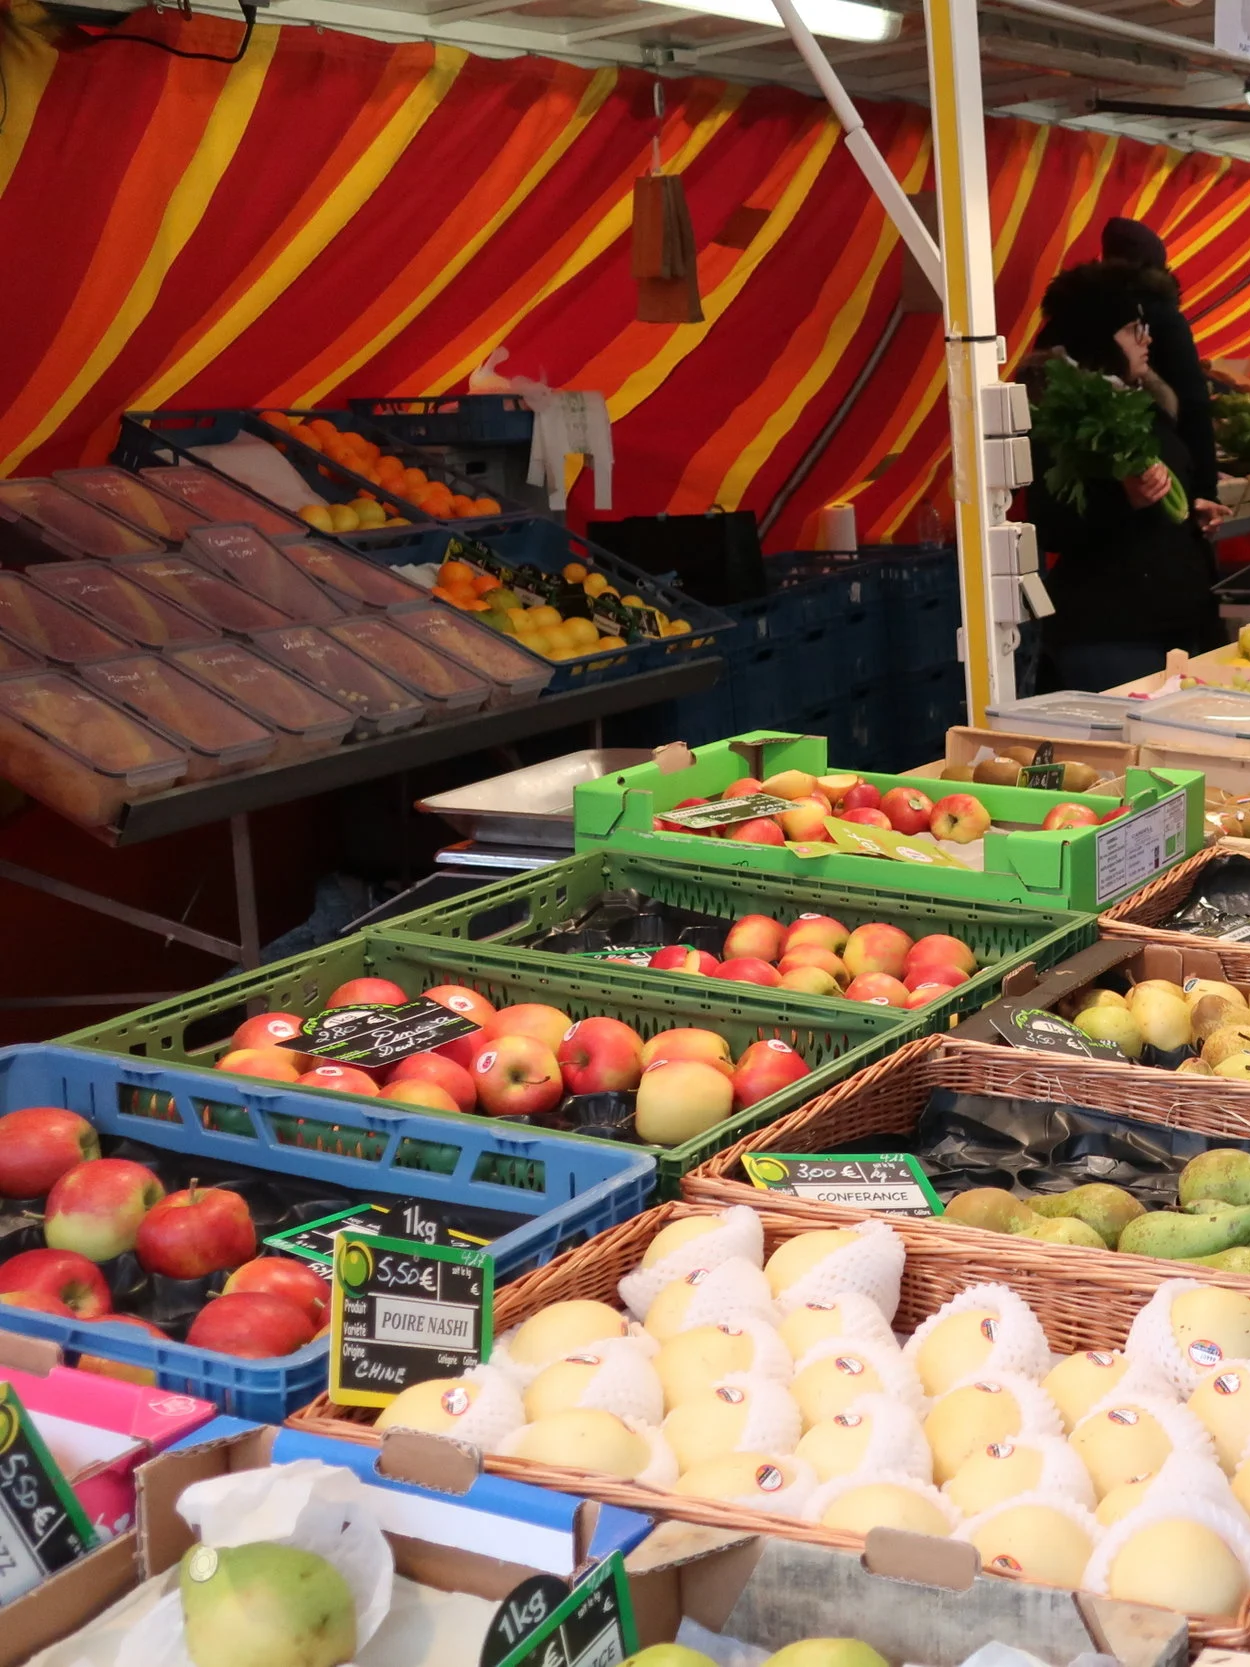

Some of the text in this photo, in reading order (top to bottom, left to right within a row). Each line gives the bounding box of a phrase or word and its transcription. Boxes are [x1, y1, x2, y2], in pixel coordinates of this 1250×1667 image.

[796, 1163, 862, 1181] 3,00 €
[816, 1191, 909, 1203] CONFERANCE
[402, 1204, 438, 1246] 1kg
[469, 1283, 481, 1297] €
[343, 1299, 368, 1316] Produit
[343, 1321, 368, 1338] Variété
[380, 1311, 469, 1338] POIRE NASHI
[342, 1344, 366, 1362] Origine
[354, 1359, 408, 1385] CHINE
[498, 1588, 549, 1645] 1kg
